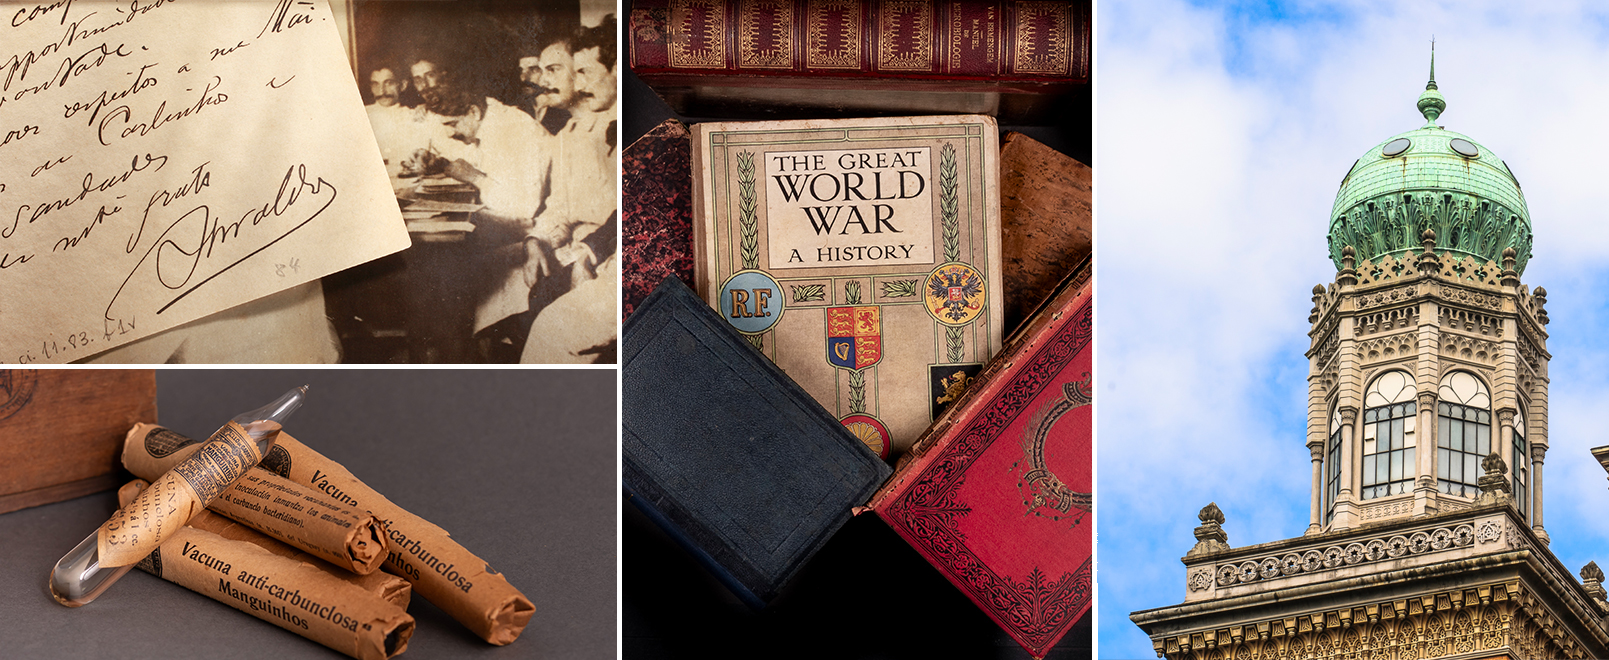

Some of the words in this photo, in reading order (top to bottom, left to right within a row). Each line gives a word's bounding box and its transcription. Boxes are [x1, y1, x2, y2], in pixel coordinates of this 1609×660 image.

[987, 5, 995, 20] VAN
[952, 2, 962, 69] MICROBIOLOGIE
[971, 18, 980, 50] MANUEL
[773, 154, 826, 172] THE
[838, 151, 922, 170] GREAT
[772, 170, 925, 203] WORLD
[799, 204, 904, 236] WAR
[275, 257, 301, 277] 84
[788, 249, 804, 263] A
[817, 244, 915, 262] HISTORY
[730, 288, 772, 318] R.F.
[310, 469, 359, 508] Vacuna
[366, 510, 473, 594] ti-carbunclosa
[181, 541, 232, 575] Vacuna
[218, 578, 309, 630] Manguinhos
